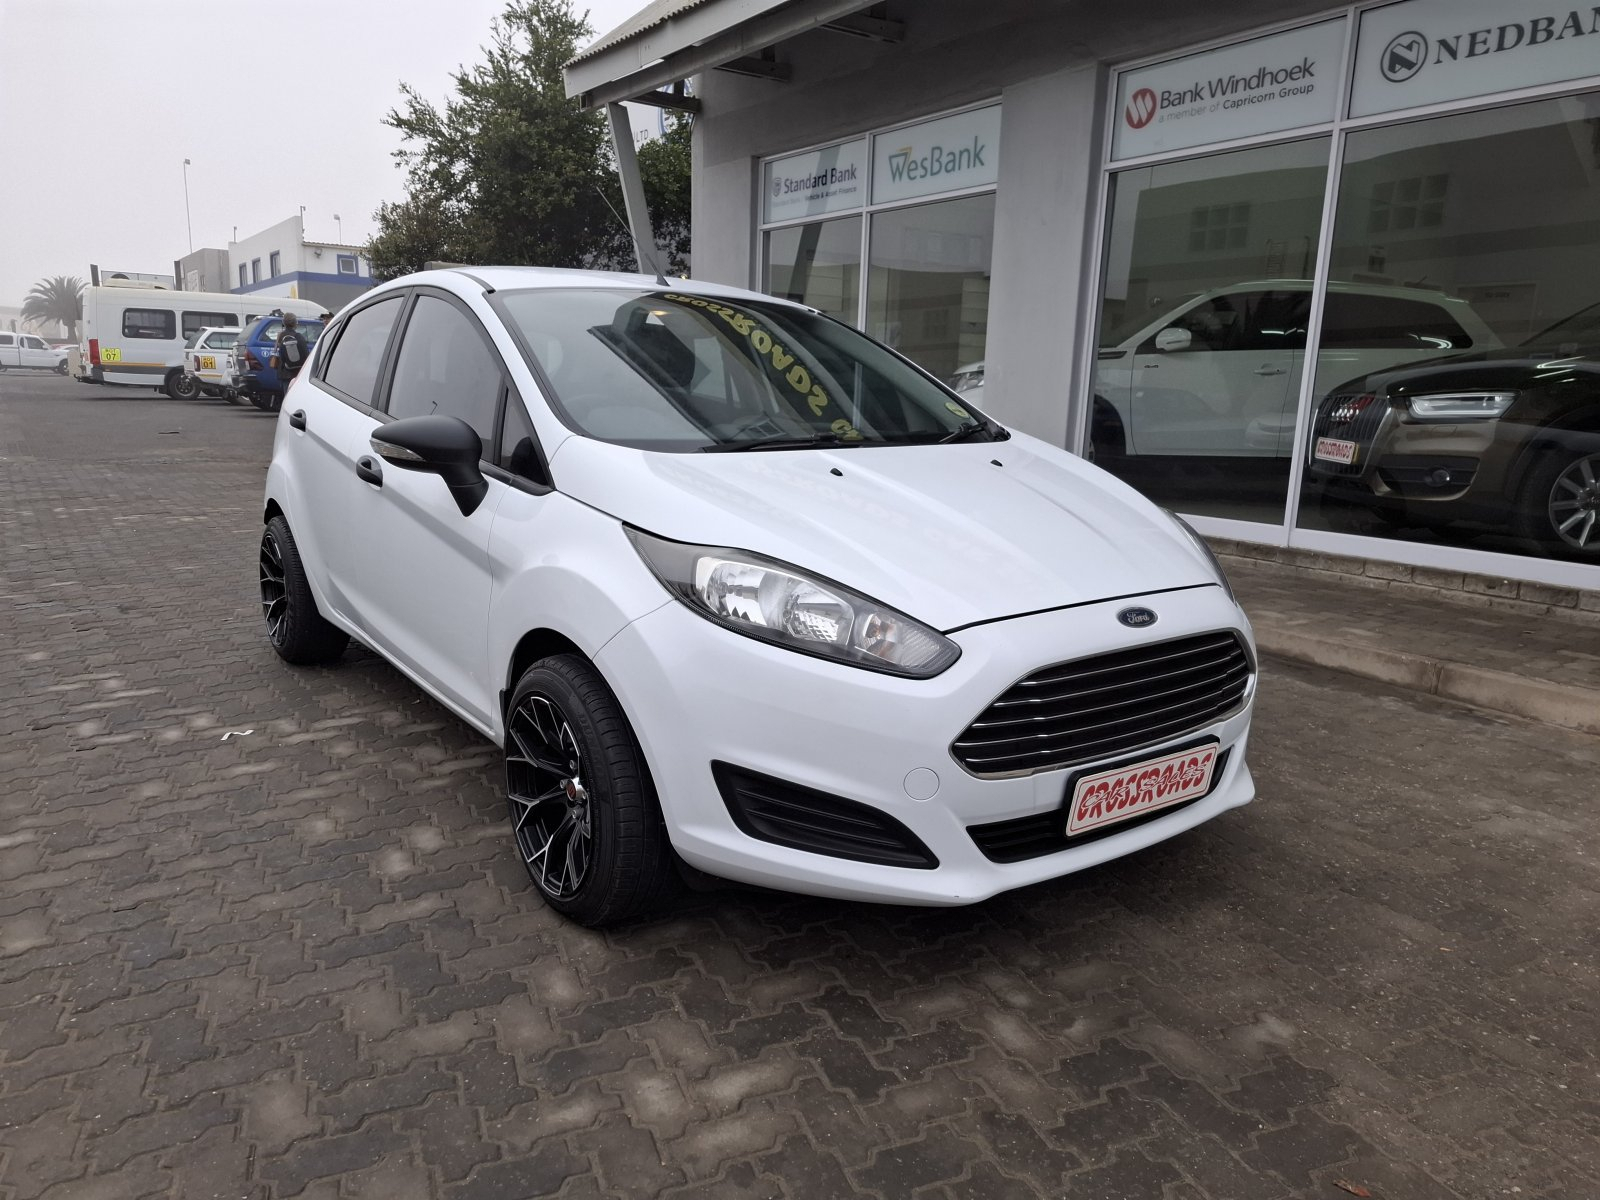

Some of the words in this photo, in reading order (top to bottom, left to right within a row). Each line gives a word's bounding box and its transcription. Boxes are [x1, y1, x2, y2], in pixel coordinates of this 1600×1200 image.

[1160, 82, 1205, 110] Bank
[1208, 57, 1316, 99] Windhoek
[1167, 105, 1206, 121] member
[1210, 103, 1221, 113] of
[1223, 91, 1275, 110] Capricorn
[1279, 84, 1315, 99] Group
[888, 135, 986, 183] WesBank
[784, 169, 828, 194] Standard
[830, 163, 857, 185] Bank
[1126, 612, 1150, 624] Ford
